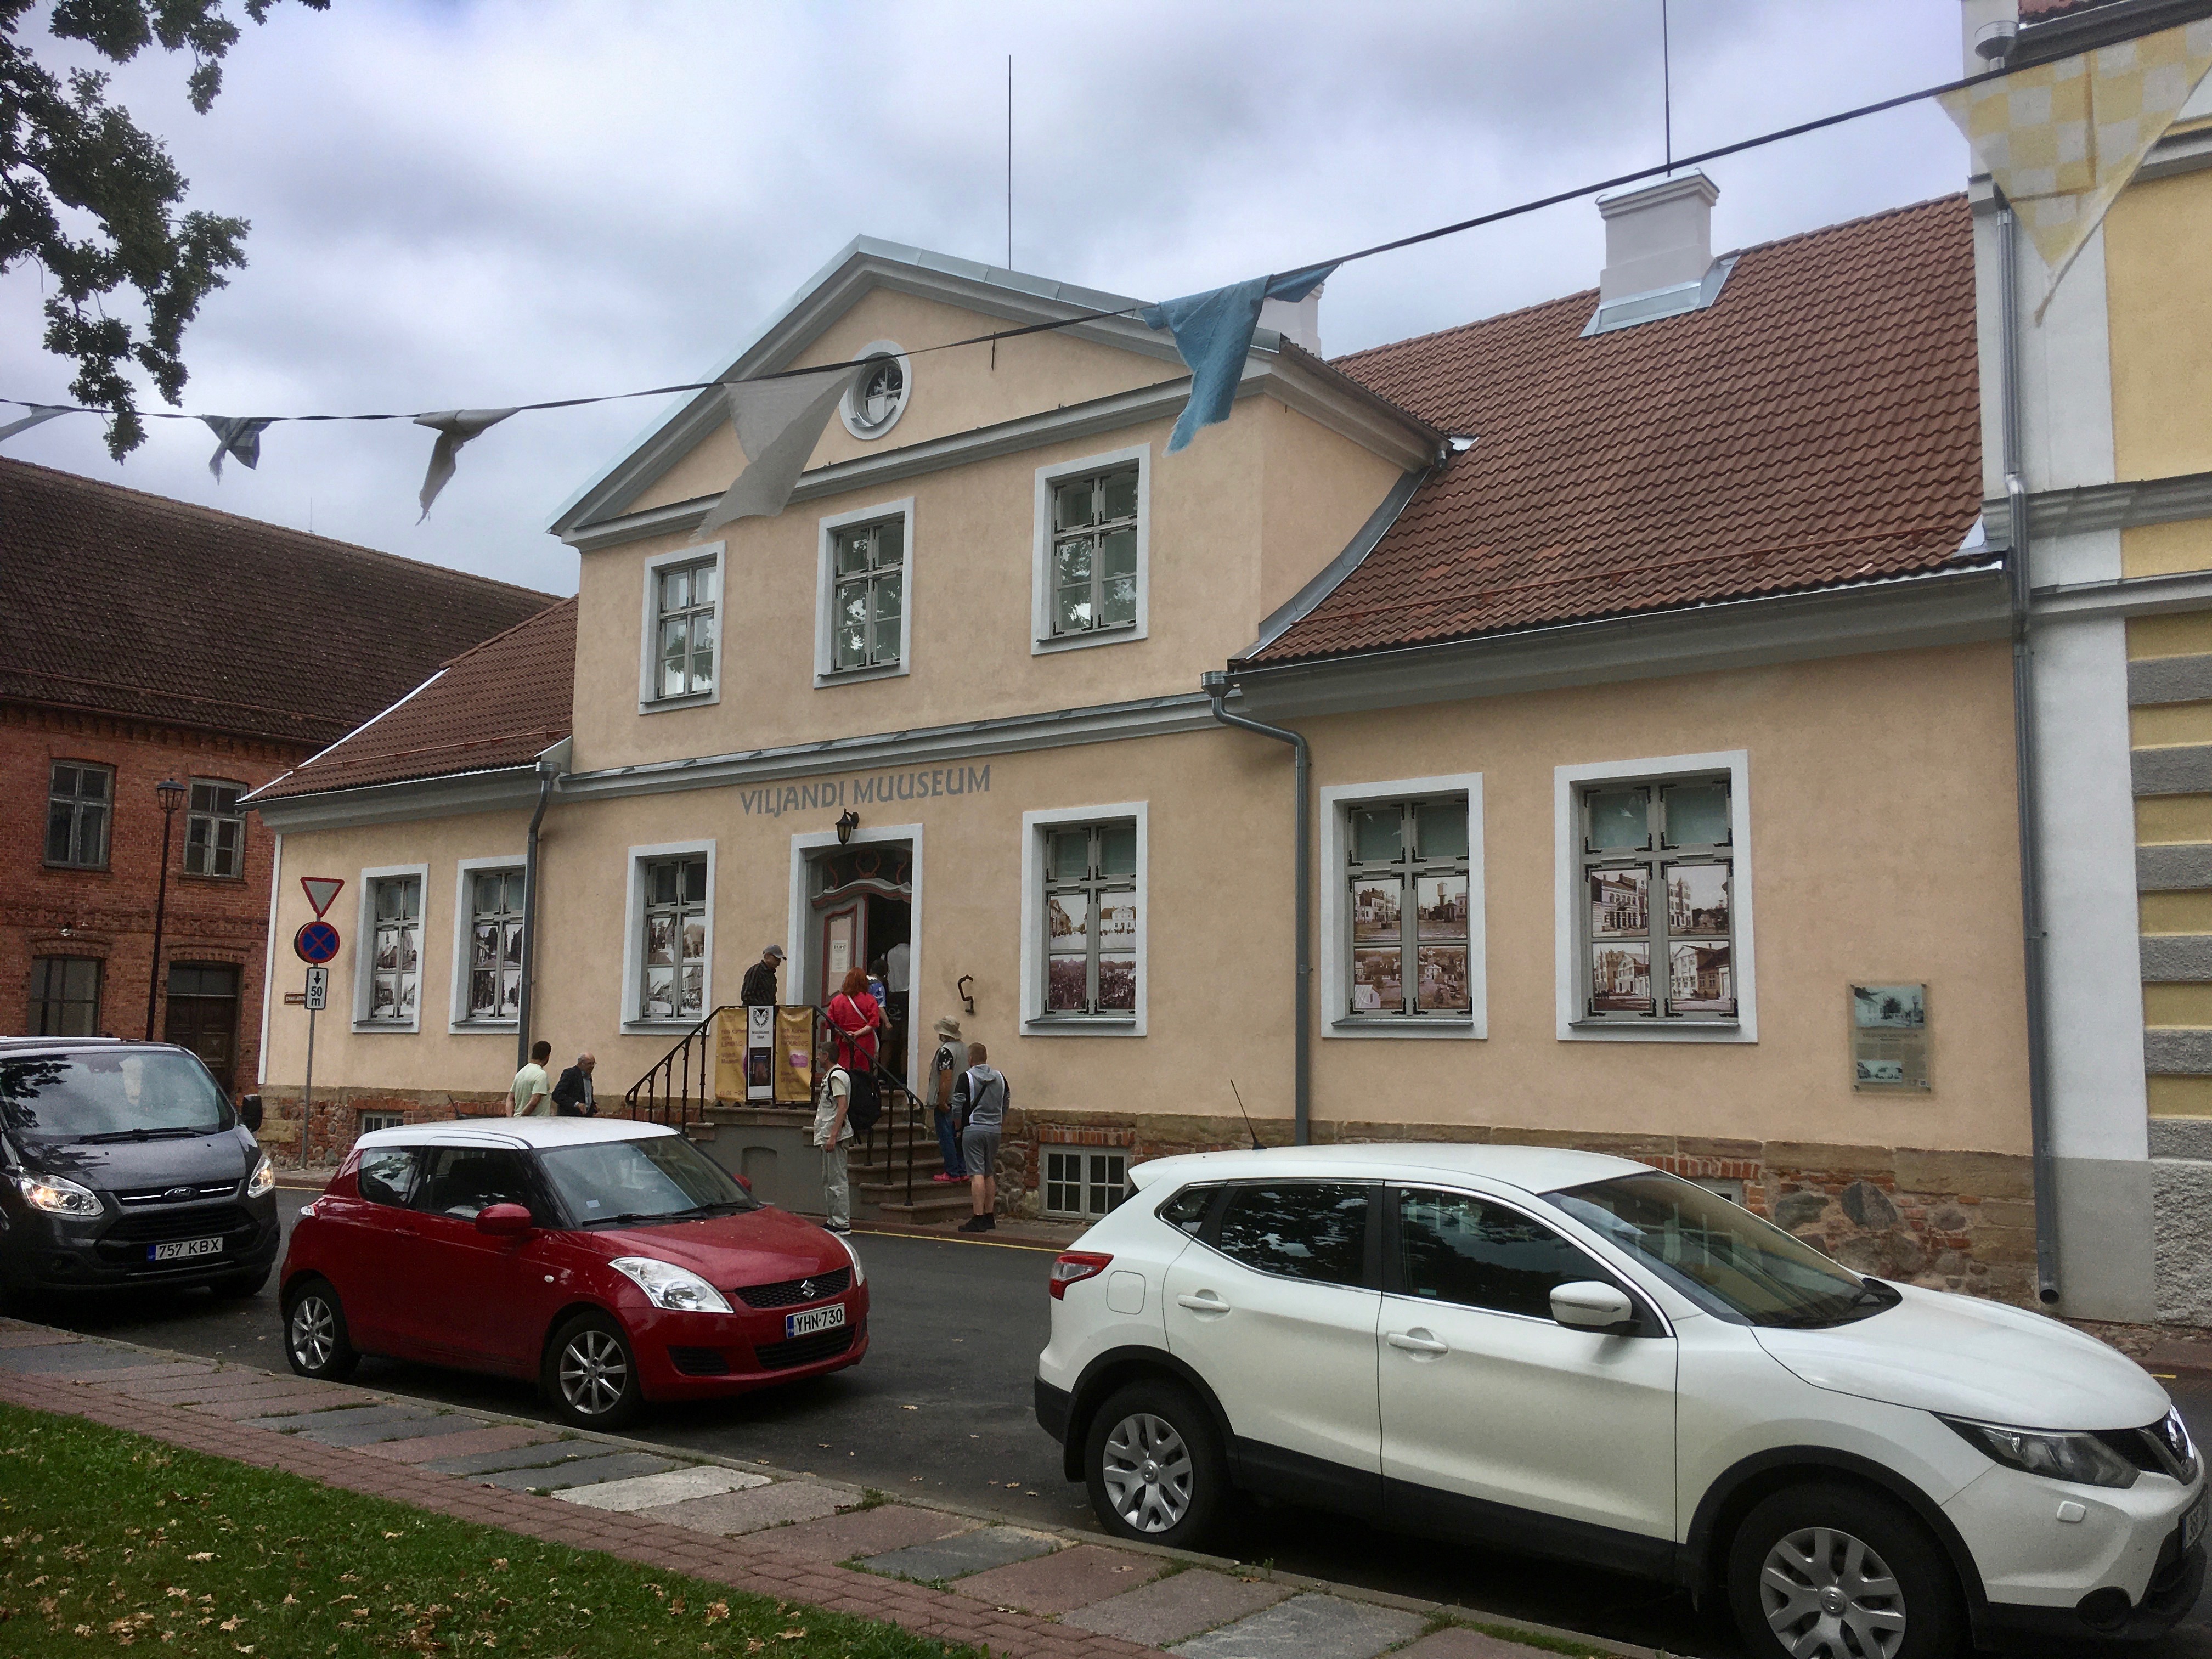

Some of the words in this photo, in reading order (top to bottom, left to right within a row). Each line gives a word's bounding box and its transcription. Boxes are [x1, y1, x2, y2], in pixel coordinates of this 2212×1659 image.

[740, 781, 845, 818] VILJANDI
[853, 765, 991, 805] MUUSEUM
[311, 986, 323, 997] 50
[311, 998, 320, 1006] m
[159, 1243, 183, 1258] 757
[189, 1238, 219, 1254] KBX
[797, 1308, 843, 1333] YHN-730
